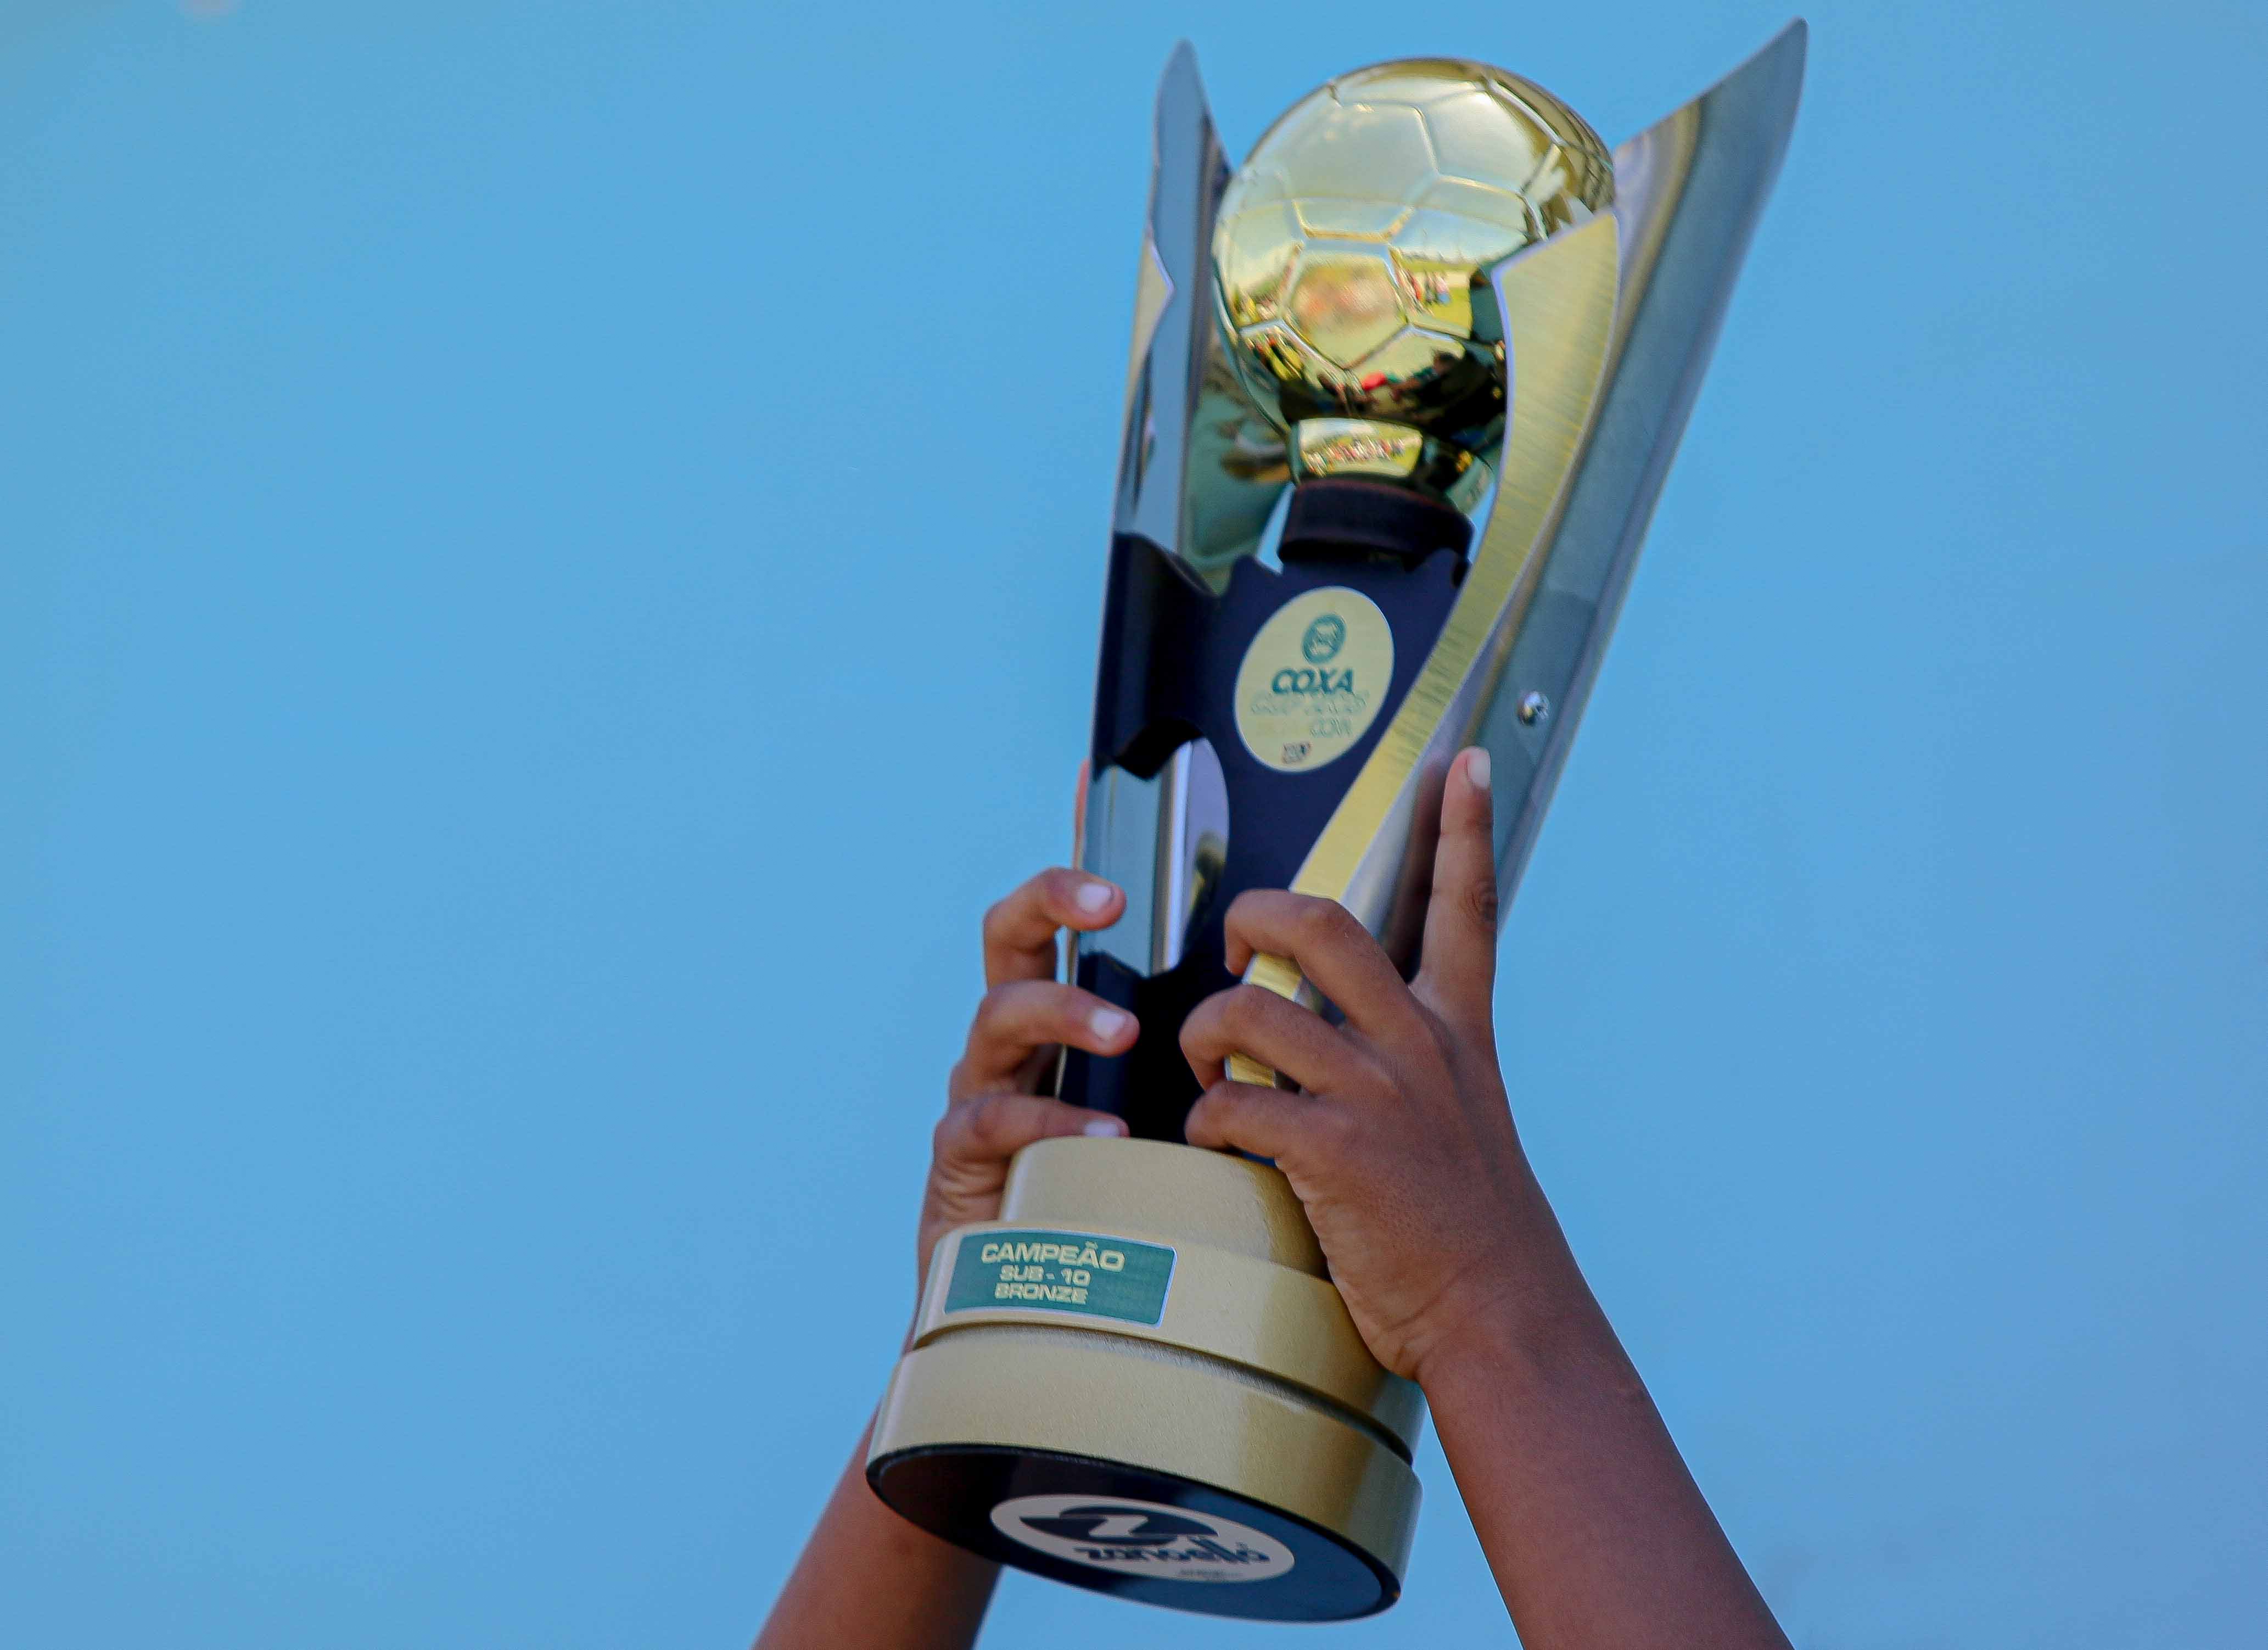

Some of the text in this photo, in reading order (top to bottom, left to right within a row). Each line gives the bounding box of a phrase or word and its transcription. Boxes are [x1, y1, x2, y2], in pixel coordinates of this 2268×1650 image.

[1272, 668, 1353, 695] COXA
[981, 1241, 1125, 1272] CAMPEÃO
[1000, 1264, 1044, 1282] SUB
[1061, 1268, 1091, 1287] 10
[995, 1282, 1088, 1305] BRONZE
